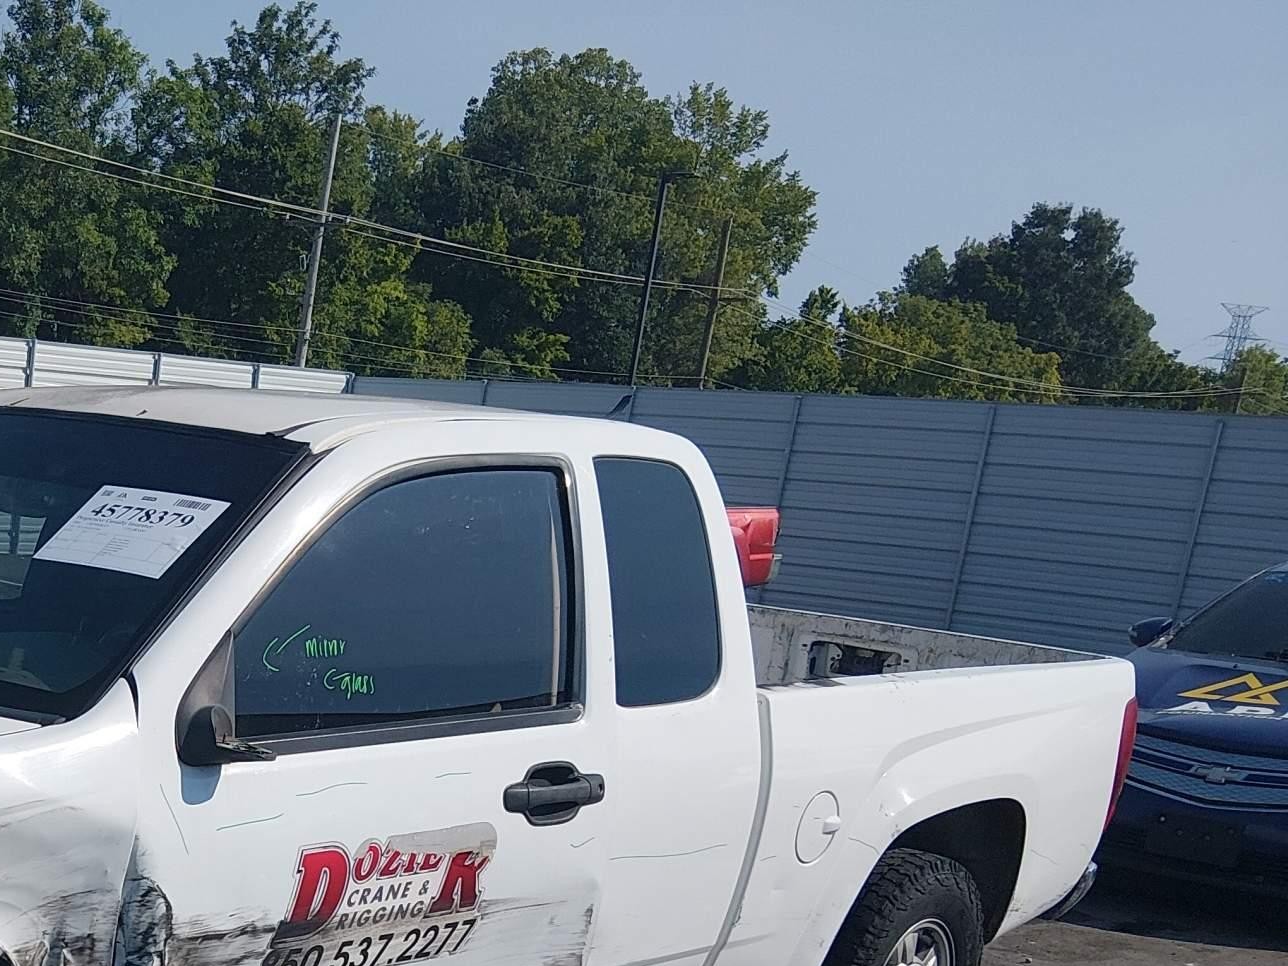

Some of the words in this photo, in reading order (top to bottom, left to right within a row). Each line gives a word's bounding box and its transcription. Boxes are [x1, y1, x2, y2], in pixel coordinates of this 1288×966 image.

[91, 503, 195, 528] 45778379
[347, 881, 413, 907] CRANE
[418, 879, 430, 895] &
[335, 900, 425, 931] RIGGING
